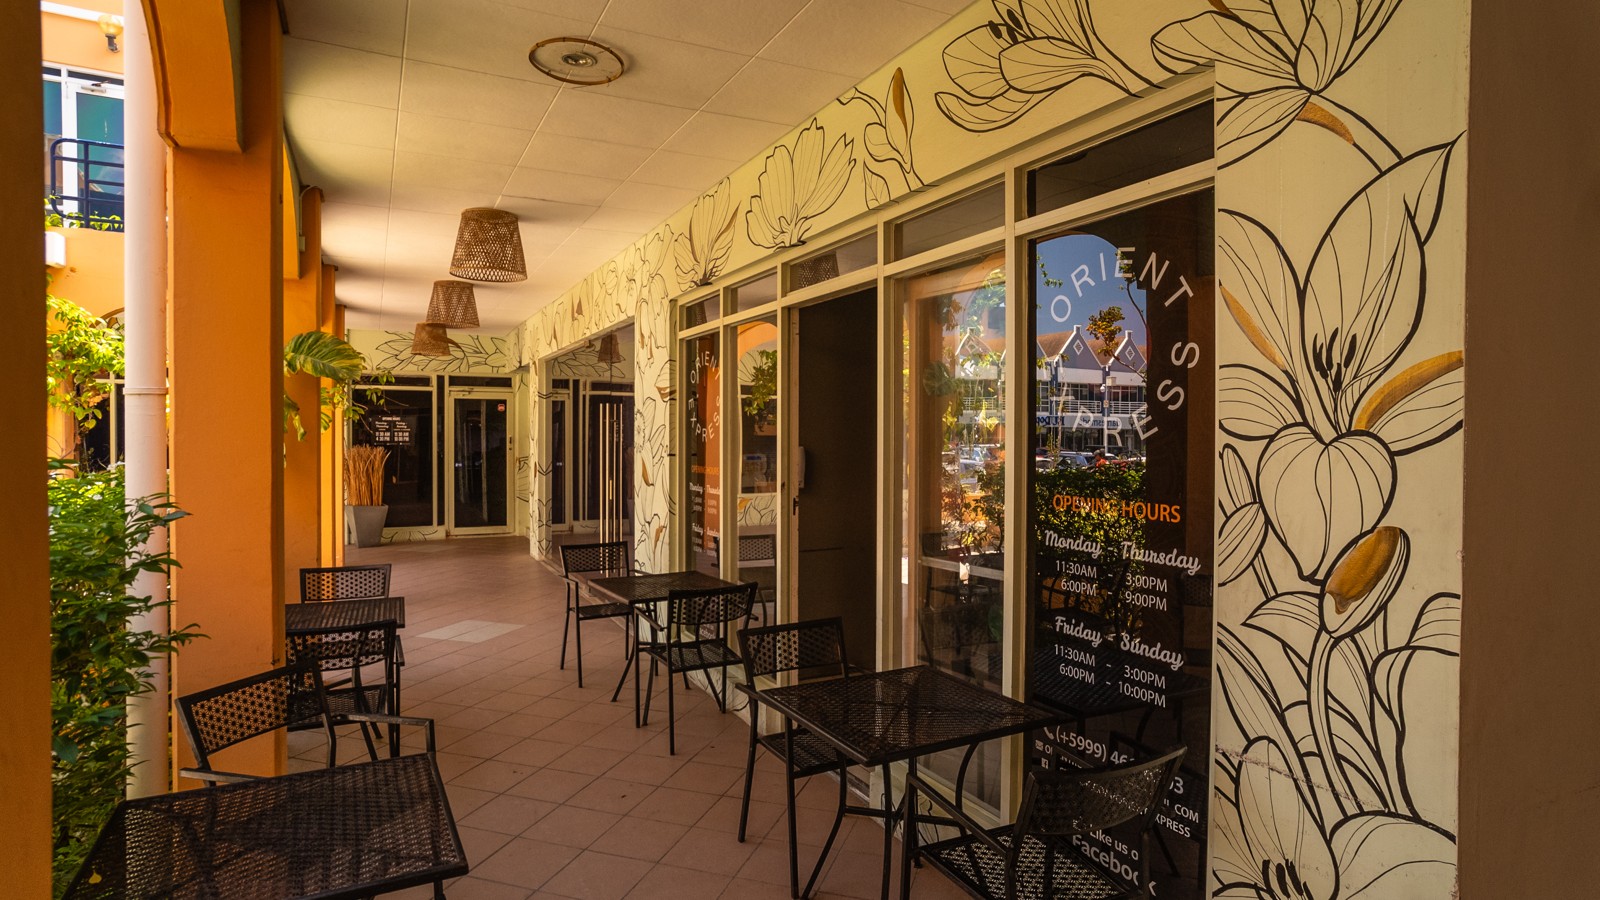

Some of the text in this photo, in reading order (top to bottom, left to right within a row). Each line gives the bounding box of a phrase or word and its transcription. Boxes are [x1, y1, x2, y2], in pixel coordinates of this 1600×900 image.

[1050, 246, 1194, 323] ORIENT
[1053, 494, 1181, 523] OPENING HOURS
[1045, 529, 1102, 559] Monday
[1120, 541, 1201, 576] Thursday
[1055, 560, 1097, 579] 11:30AM
[1125, 573, 1168, 593] 3:00PM
[1061, 578, 1097, 597] 6:00PM
[1125, 591, 1167, 612] 9:00PM
[1055, 615, 1102, 648] Friday
[1120, 632, 1184, 671] Sunday
[1054, 644, 1096, 667] 11:30AM
[1124, 665, 1166, 690] 3:00PM
[1059, 663, 1095, 685] 6:00PM
[1118, 681, 1166, 708] 10:00PM
[1056, 725, 1107, 762] (+5999)
[1110, 750, 1136, 766] 46
[1154, 813, 1191, 838] XPRESS
[1115, 840, 1129, 855] us
